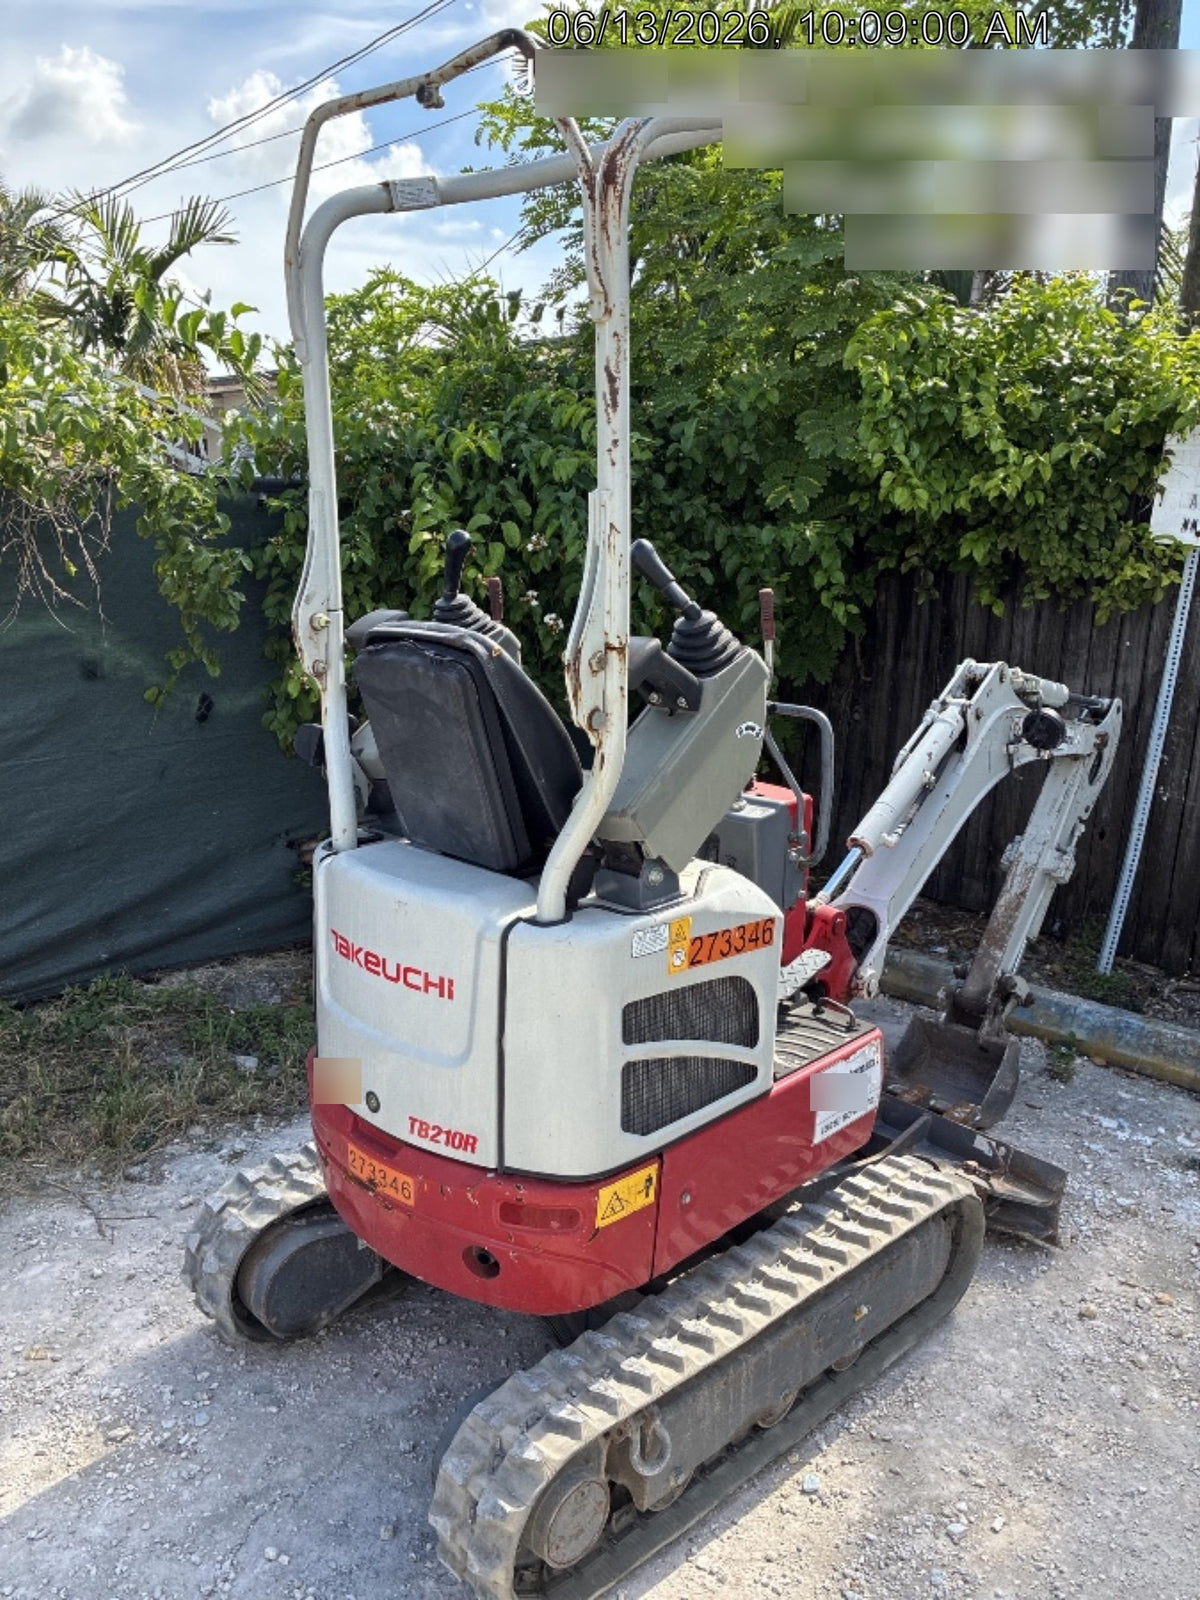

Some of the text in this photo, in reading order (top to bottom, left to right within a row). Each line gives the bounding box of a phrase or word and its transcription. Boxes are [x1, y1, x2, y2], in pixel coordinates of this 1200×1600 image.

[689, 918, 775, 966] 273346
[408, 1116, 479, 1154] TB210R
[349, 1149, 412, 1200] 273346
